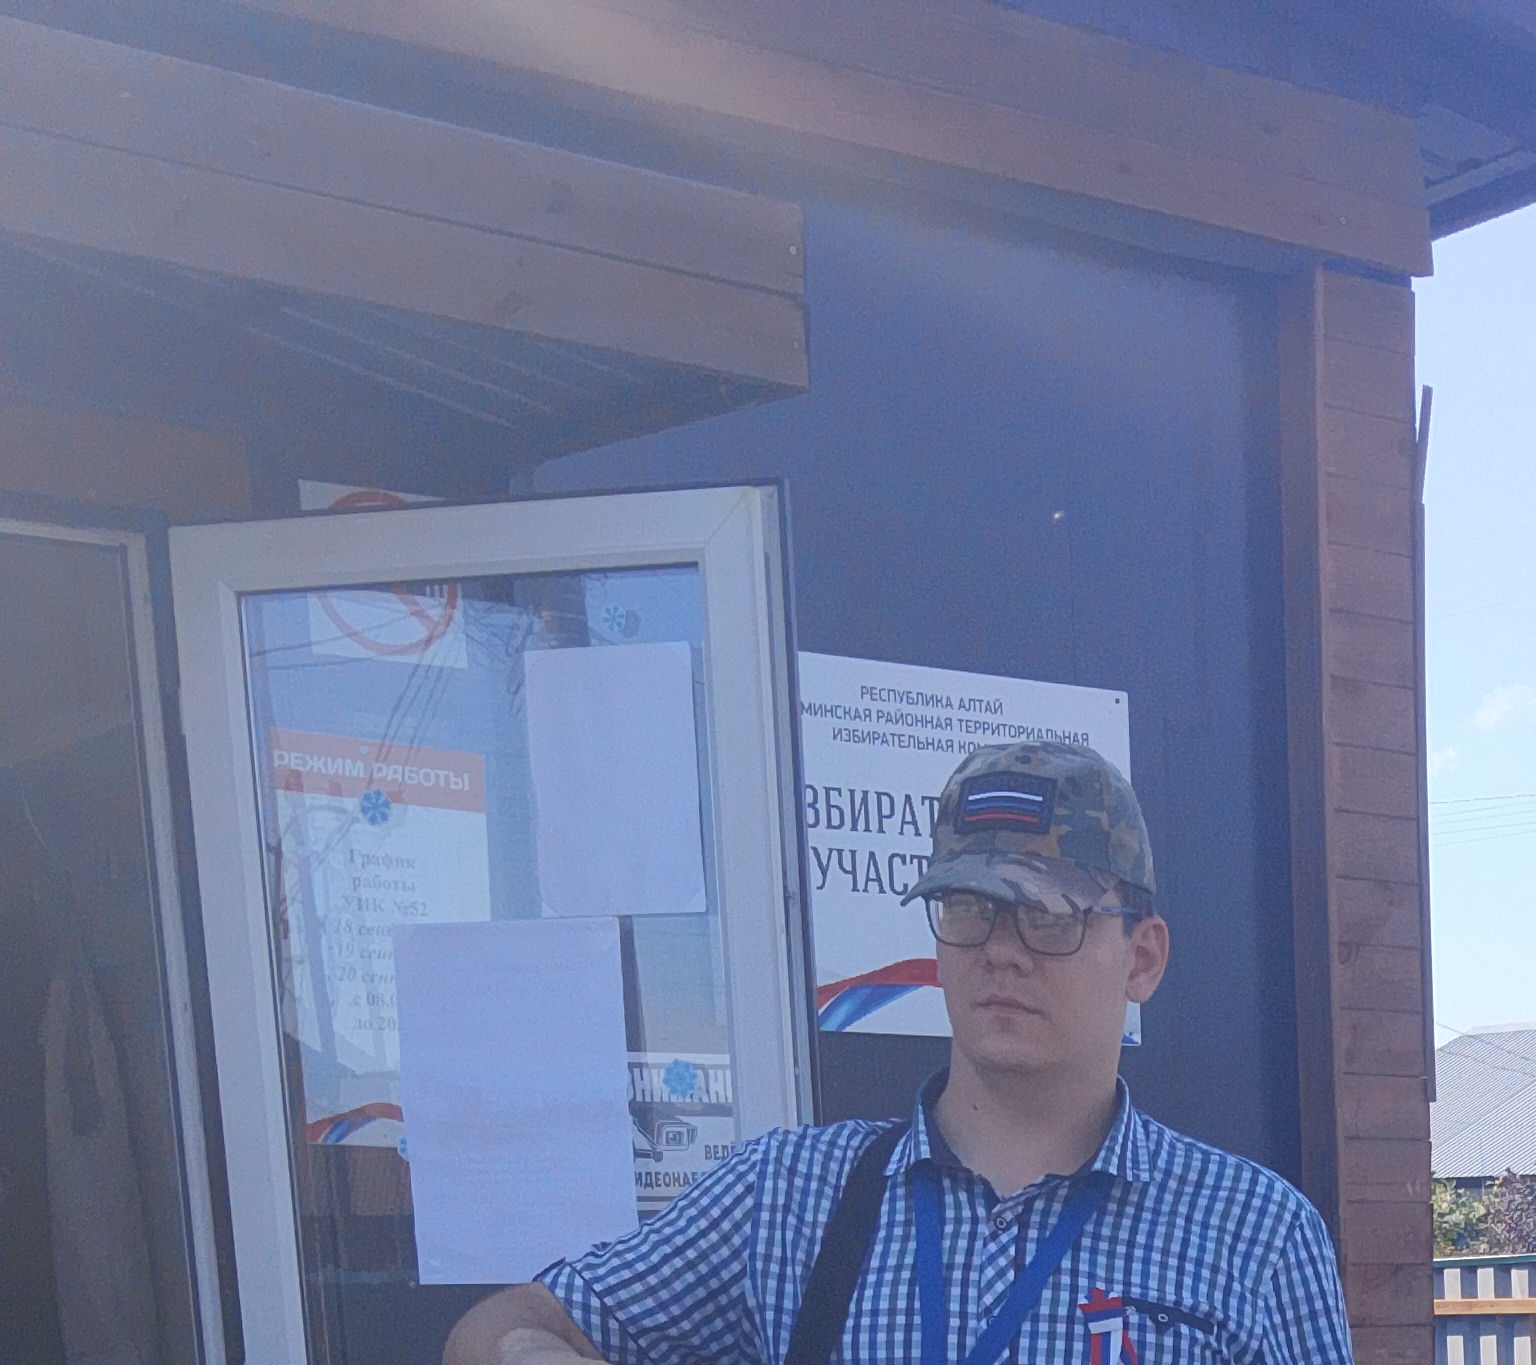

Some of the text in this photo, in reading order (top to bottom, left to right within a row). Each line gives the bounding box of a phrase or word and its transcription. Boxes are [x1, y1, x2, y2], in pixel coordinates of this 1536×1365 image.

[860, 685, 1003, 716] РЕСПУБЛИКА АЛТАЙ
[832, 727, 954, 754] ИЗБИРАТЕЛЬНАЯ
[876, 708, 953, 732] РАЙОННАЯ
[957, 718, 1089, 747] ТЕРРИТОРИАЛЬНАЯ
[274, 750, 470, 791] РЕЖИМ РАБОТЫ
[352, 874, 416, 892] работы
